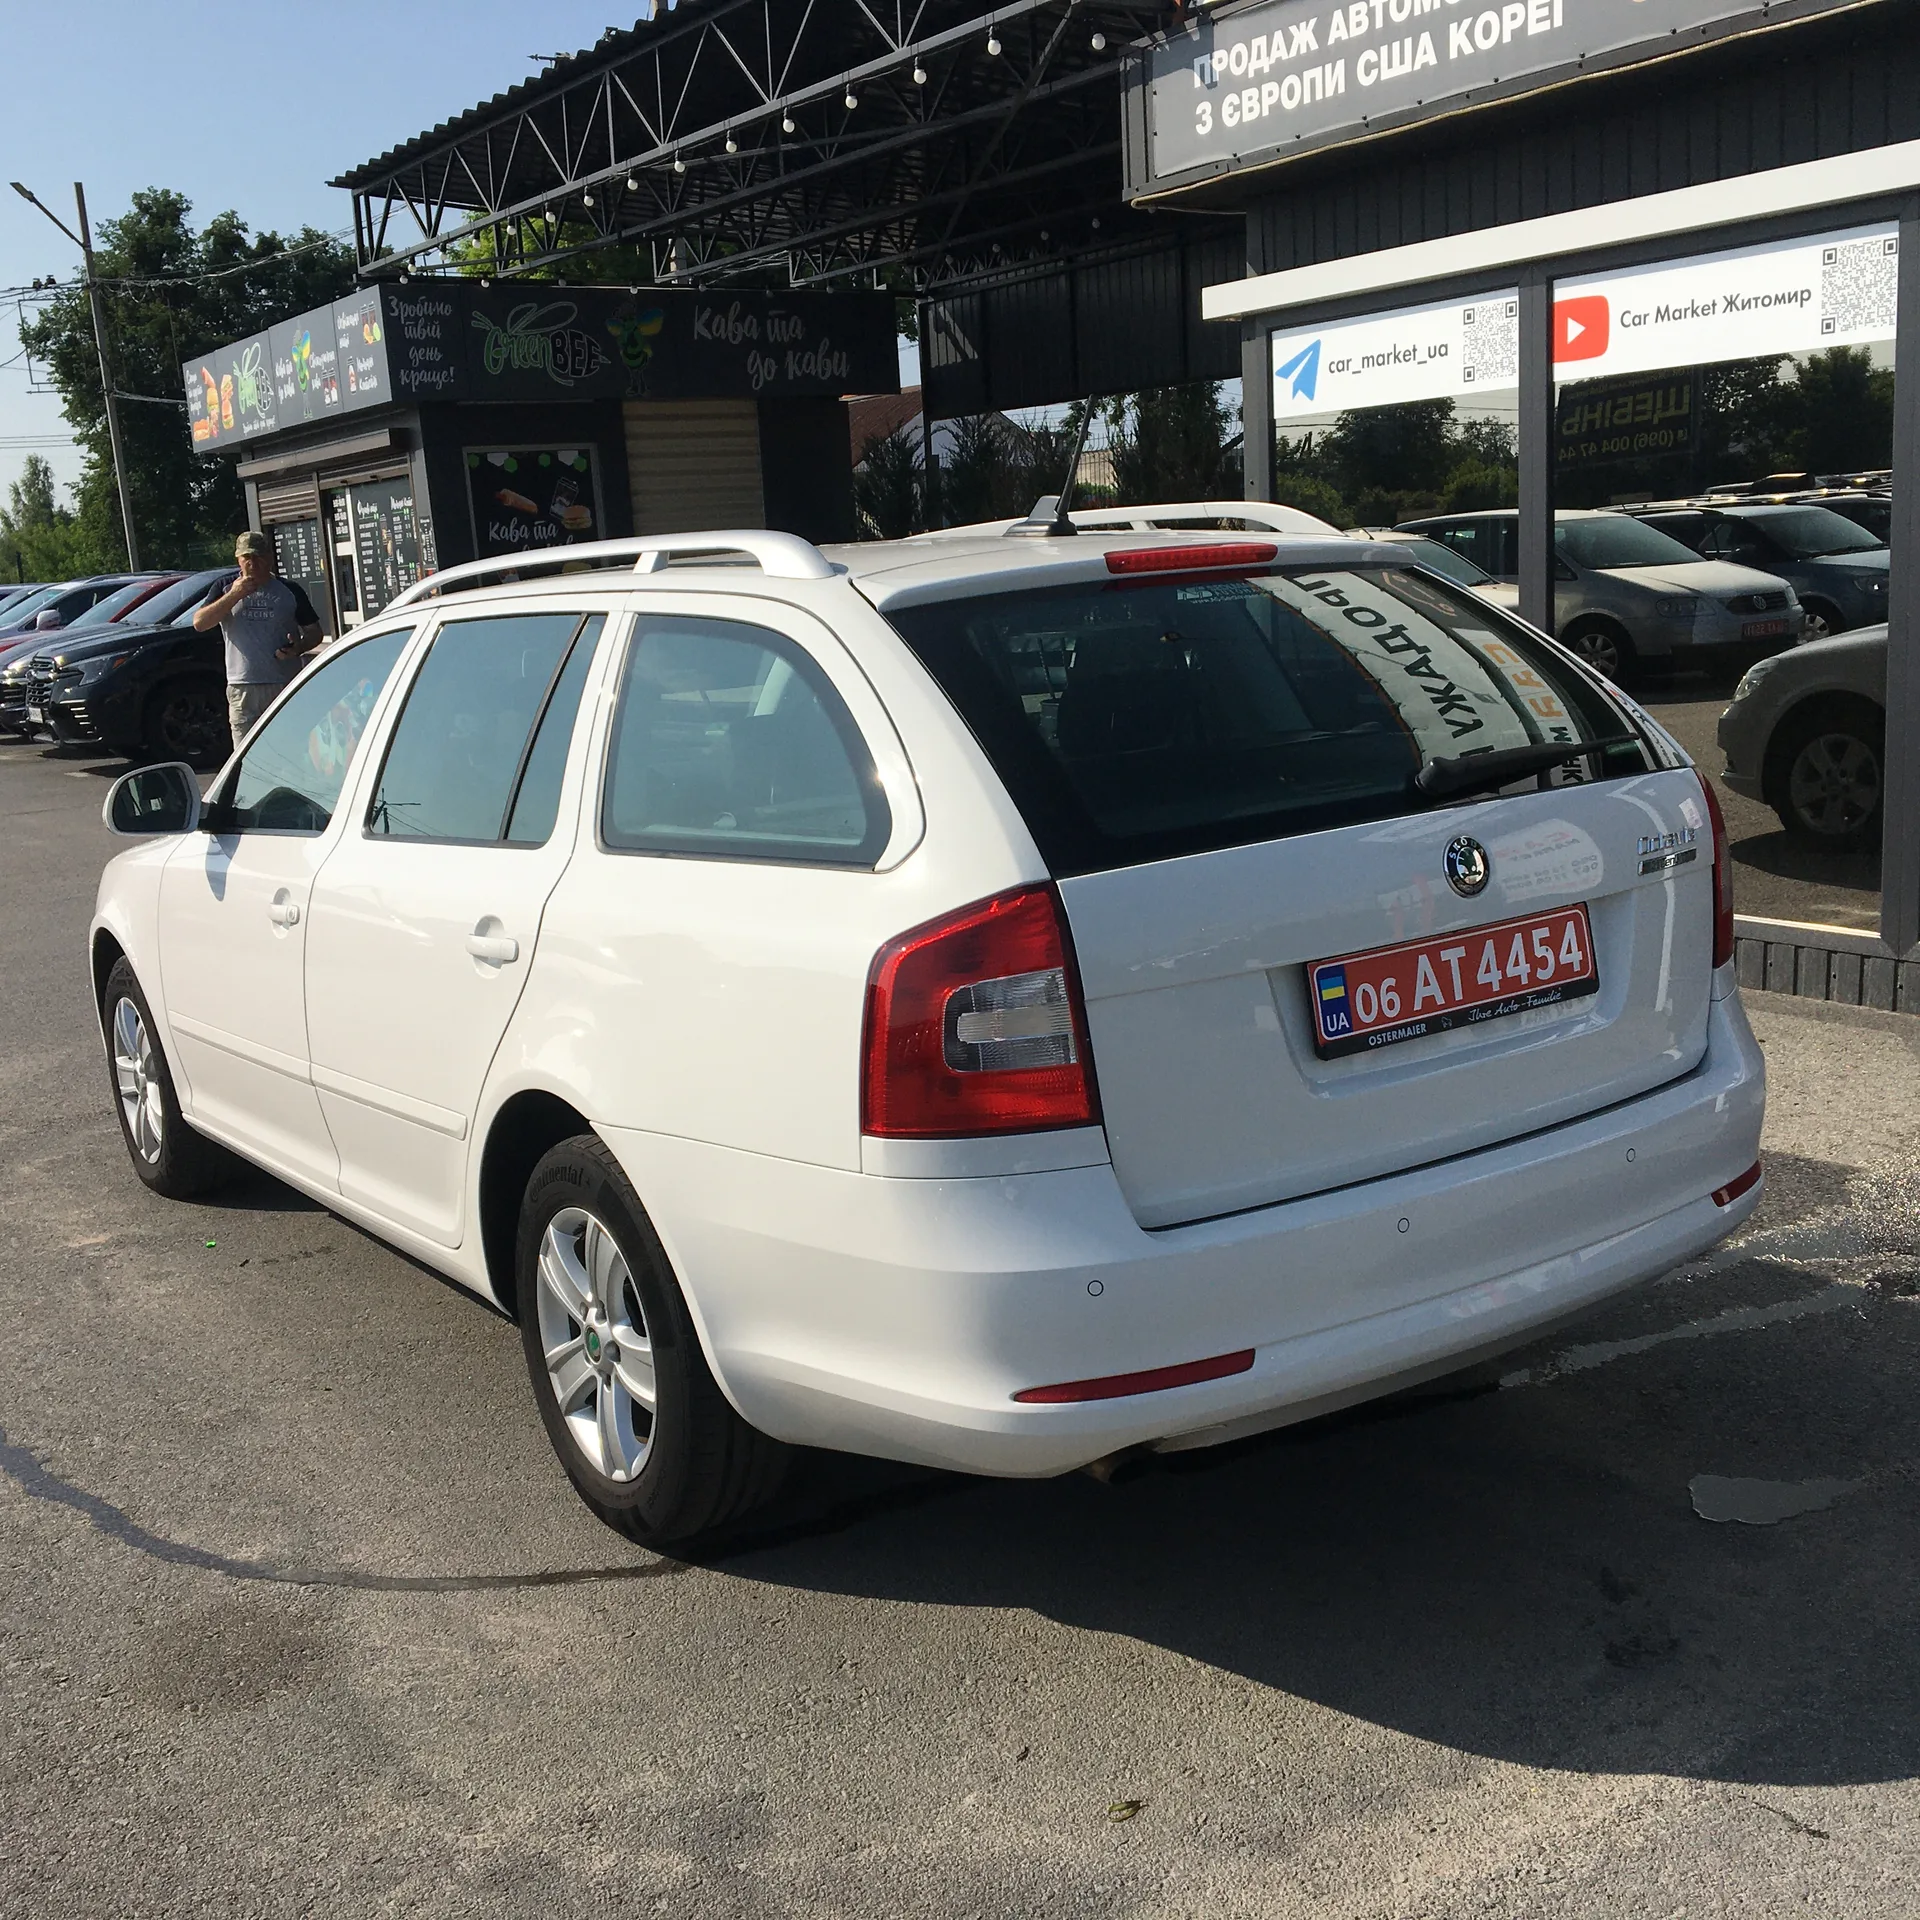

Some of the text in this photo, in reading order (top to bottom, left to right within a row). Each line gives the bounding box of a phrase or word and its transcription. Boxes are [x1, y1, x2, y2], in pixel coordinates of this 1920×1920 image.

[1193, 0, 1469, 89] ПРОДАЖ АВТО
[1221, 59, 1347, 128] ЄВРОПИ
[1356, 32, 1438, 87] США
[388, 296, 452, 324] Зробимо
[694, 300, 805, 345] Кава та
[1620, 286, 1813, 329] Car Market Житомир
[404, 317, 442, 341] твій
[409, 345, 443, 368] день
[747, 337, 850, 391] до кави
[1328, 339, 1449, 375] car_market_ua
[400, 365, 455, 393] краще!
[488, 517, 530, 543] Кава
[241, 611, 275, 619] RACING
[1355, 920, 1583, 1024] 06 AT 4454
[1326, 1011, 1350, 1032] UA
[1368, 1022, 1427, 1046] OSTERMAIER
[1468, 1008, 1492, 1022] Ihre
